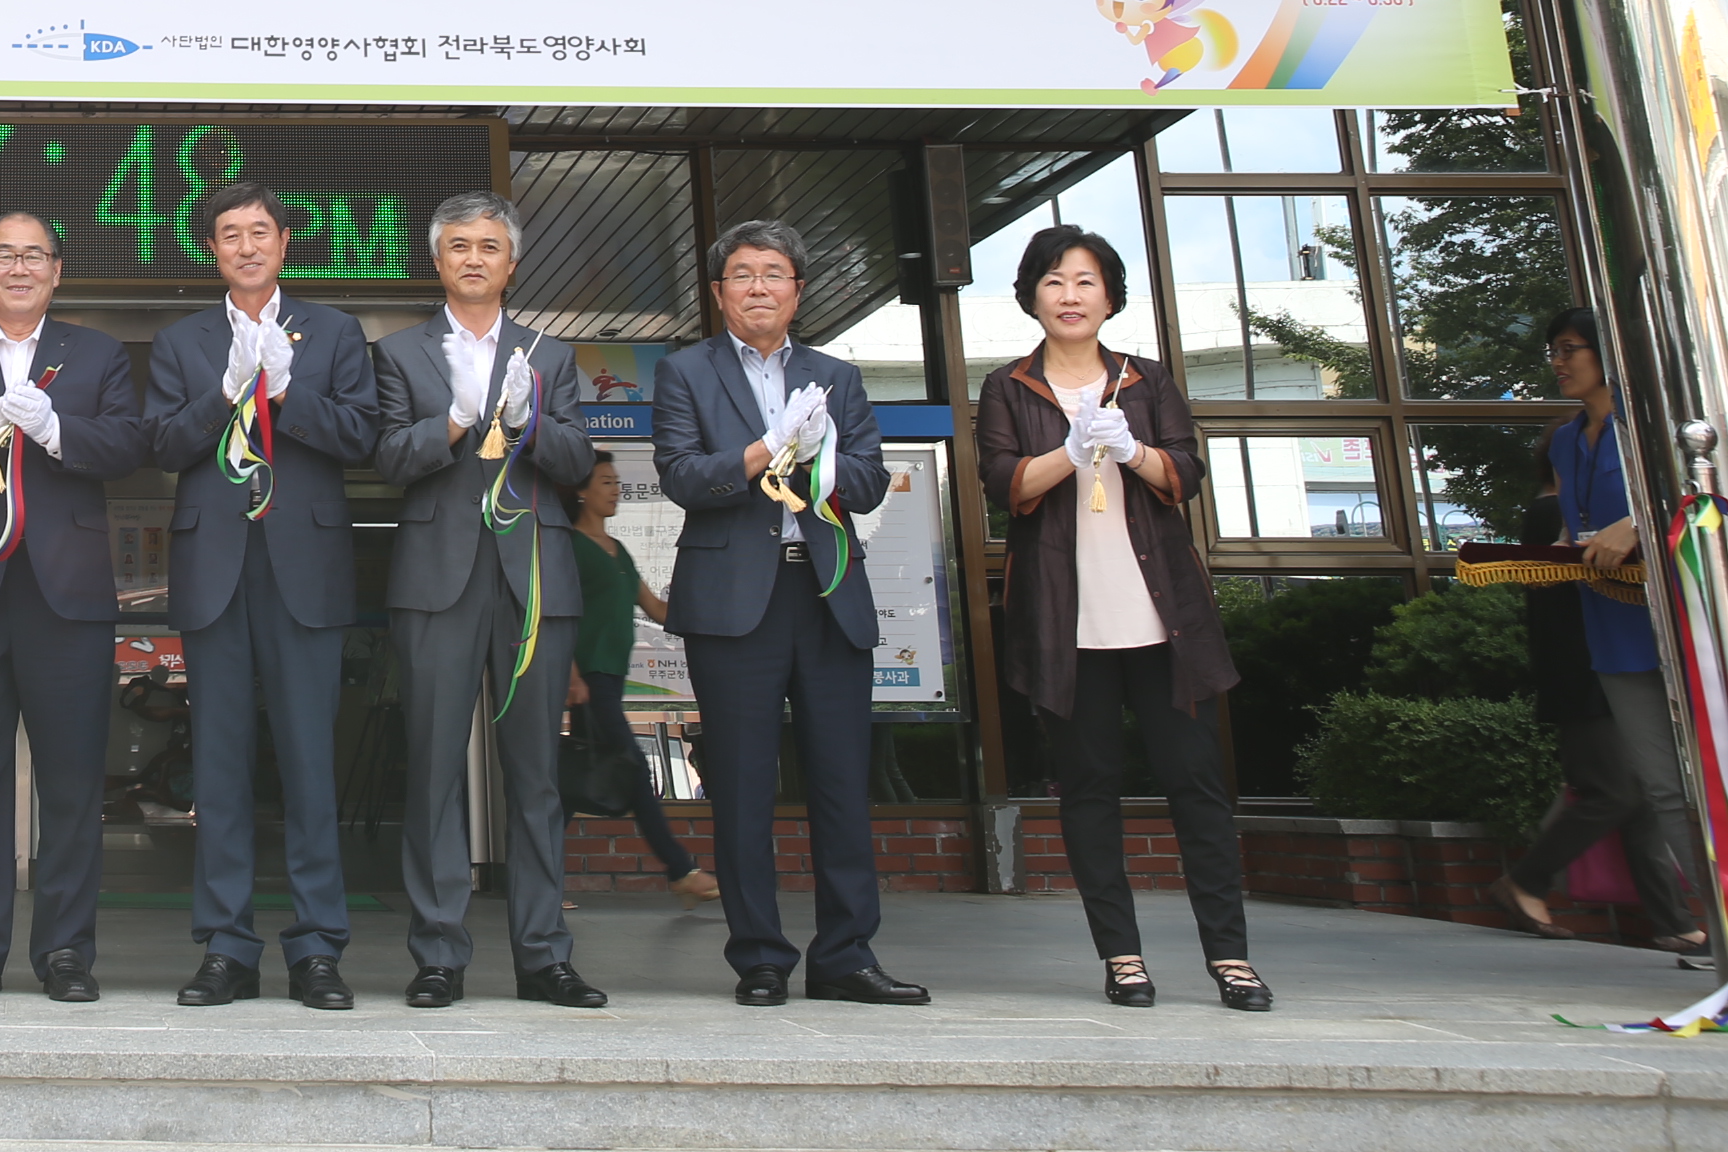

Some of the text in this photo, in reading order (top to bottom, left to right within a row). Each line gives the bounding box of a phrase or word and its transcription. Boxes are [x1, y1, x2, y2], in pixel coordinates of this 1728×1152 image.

[89, 40, 127, 54] KDA
[160, 34, 647, 61] 사단법인 대한영양사협회 전라북도영양사회
